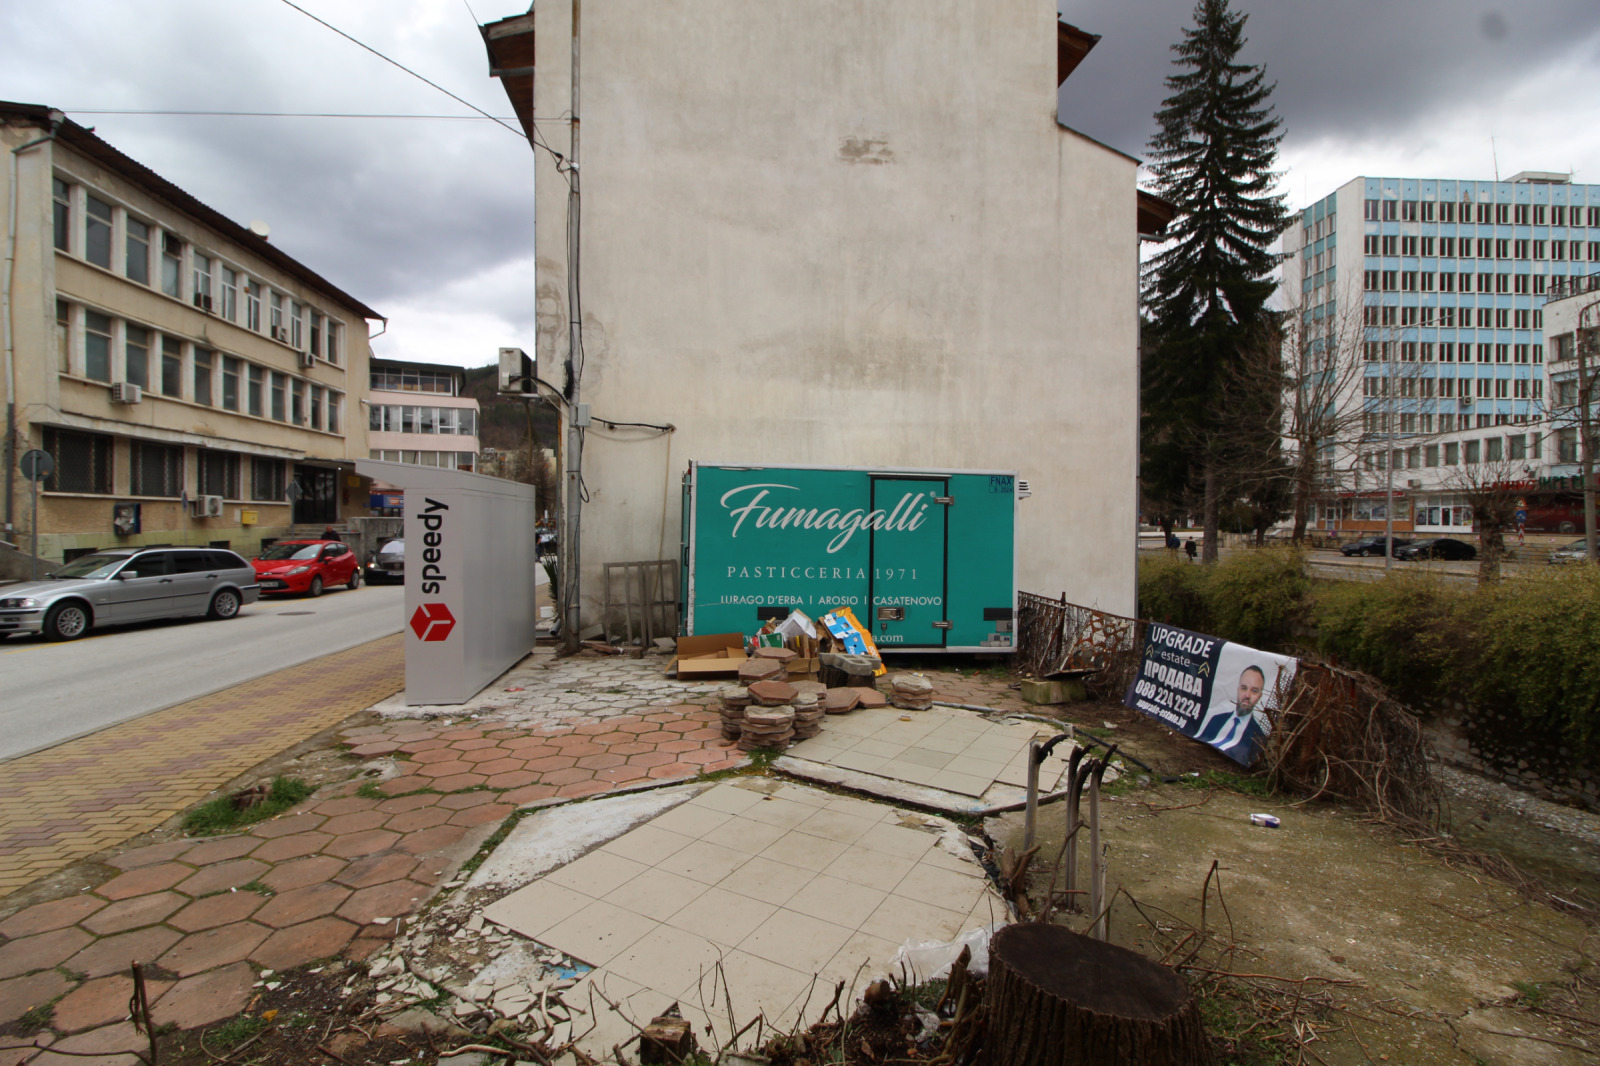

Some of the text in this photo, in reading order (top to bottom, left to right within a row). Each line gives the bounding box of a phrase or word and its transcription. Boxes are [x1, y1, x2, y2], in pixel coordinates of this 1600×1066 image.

[990, 476, 1012, 486] FNAX
[720, 483, 928, 554] Fumagalli
[417, 497, 449, 594] speedy
[727, 566, 918, 580] PASTICCERIA 1971
[720, 595, 942, 606] LURAGO D'ERBA AROSIO CASATENOVO
[1152, 626, 1214, 658] UPGRADE
[1161, 651, 1190, 667] estate
[1144, 660, 1202, 698] ПРОДАВА
[1135, 680, 1202, 720] 088 224 2224
